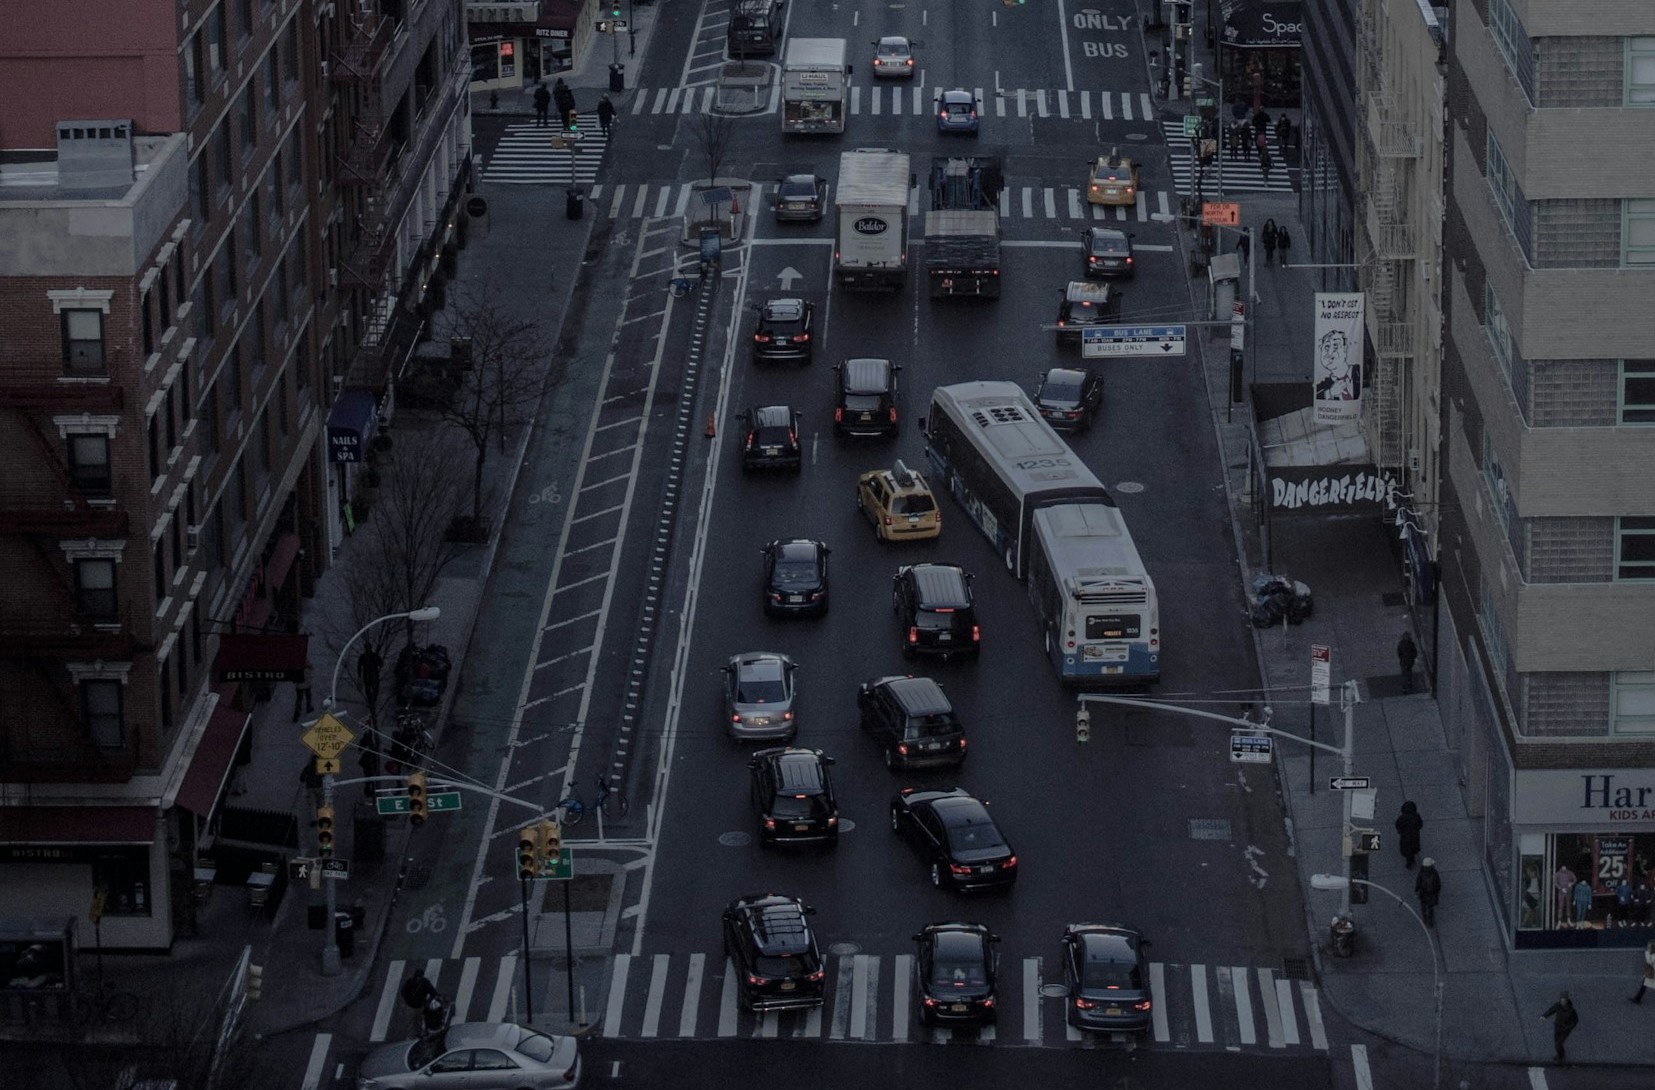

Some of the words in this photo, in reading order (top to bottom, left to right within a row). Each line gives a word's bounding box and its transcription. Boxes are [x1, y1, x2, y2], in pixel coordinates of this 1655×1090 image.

[1074, 13, 1132, 31] ONLY
[536, 28, 549, 36] RITZ
[550, 29, 569, 37] DINER
[1083, 42, 1129, 58] BUS
[858, 220, 886, 231] Baldor
[1321, 311, 1332, 319] NO
[1113, 329, 1129, 337] BUS
[1132, 328, 1153, 337] LANE
[332, 436, 358, 445] NAILS
[337, 452, 354, 461] SPA
[1017, 459, 1072, 470] 1235
[226, 671, 285, 680] BISTRO
[1580, 775, 1653, 809] Har
[395, 800, 404, 810] E
[427, 797, 443, 808] St
[1610, 810, 1638, 820] KIDS
[1601, 841, 1617, 849] Take
[1599, 856, 1624, 878] 25
